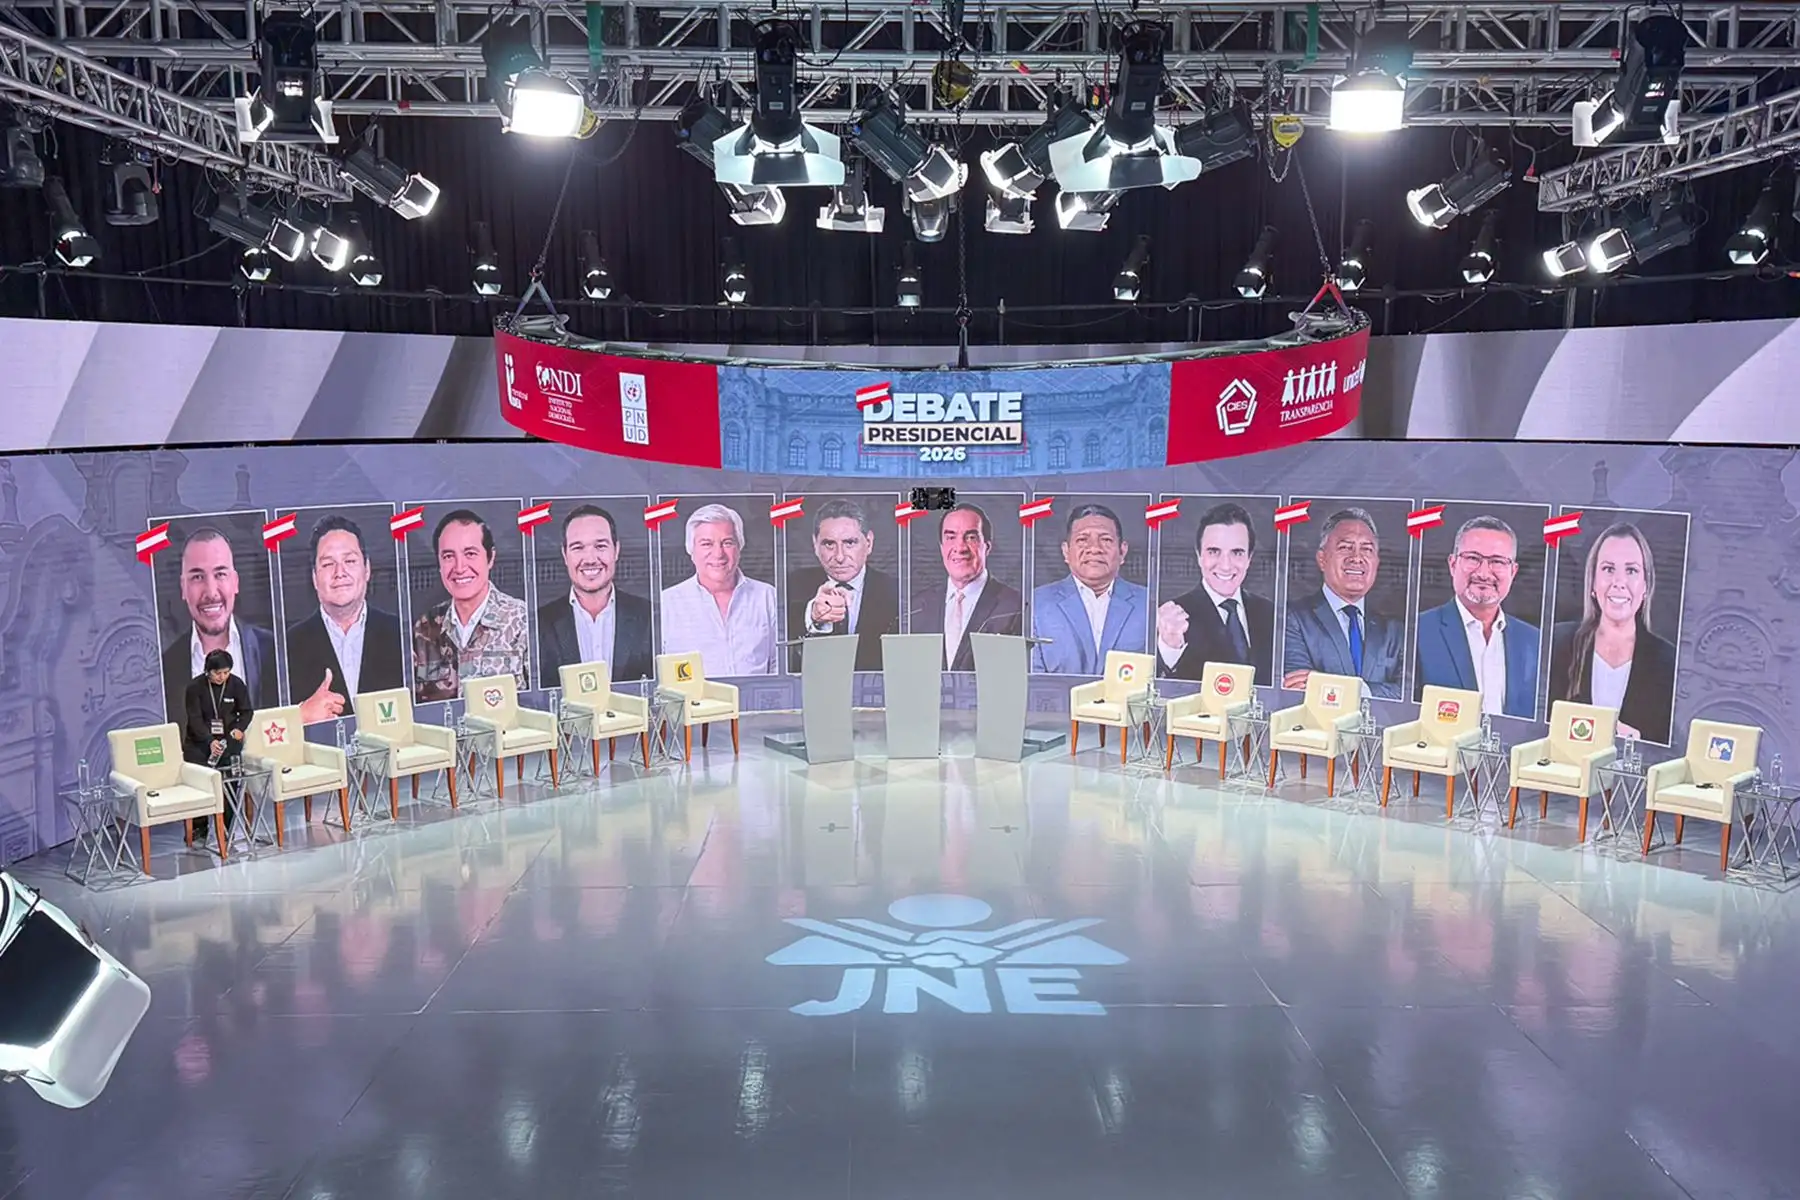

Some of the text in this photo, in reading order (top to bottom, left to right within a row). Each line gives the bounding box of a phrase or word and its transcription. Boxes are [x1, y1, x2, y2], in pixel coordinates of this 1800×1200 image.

[551, 368, 583, 397] NDI
[863, 392, 1022, 422] DEBATE
[1226, 401, 1248, 412] CIES
[868, 427, 1017, 442] PRESIDENCIAL
[919, 447, 966, 462] 2026
[788, 968, 1107, 1016] JNE
